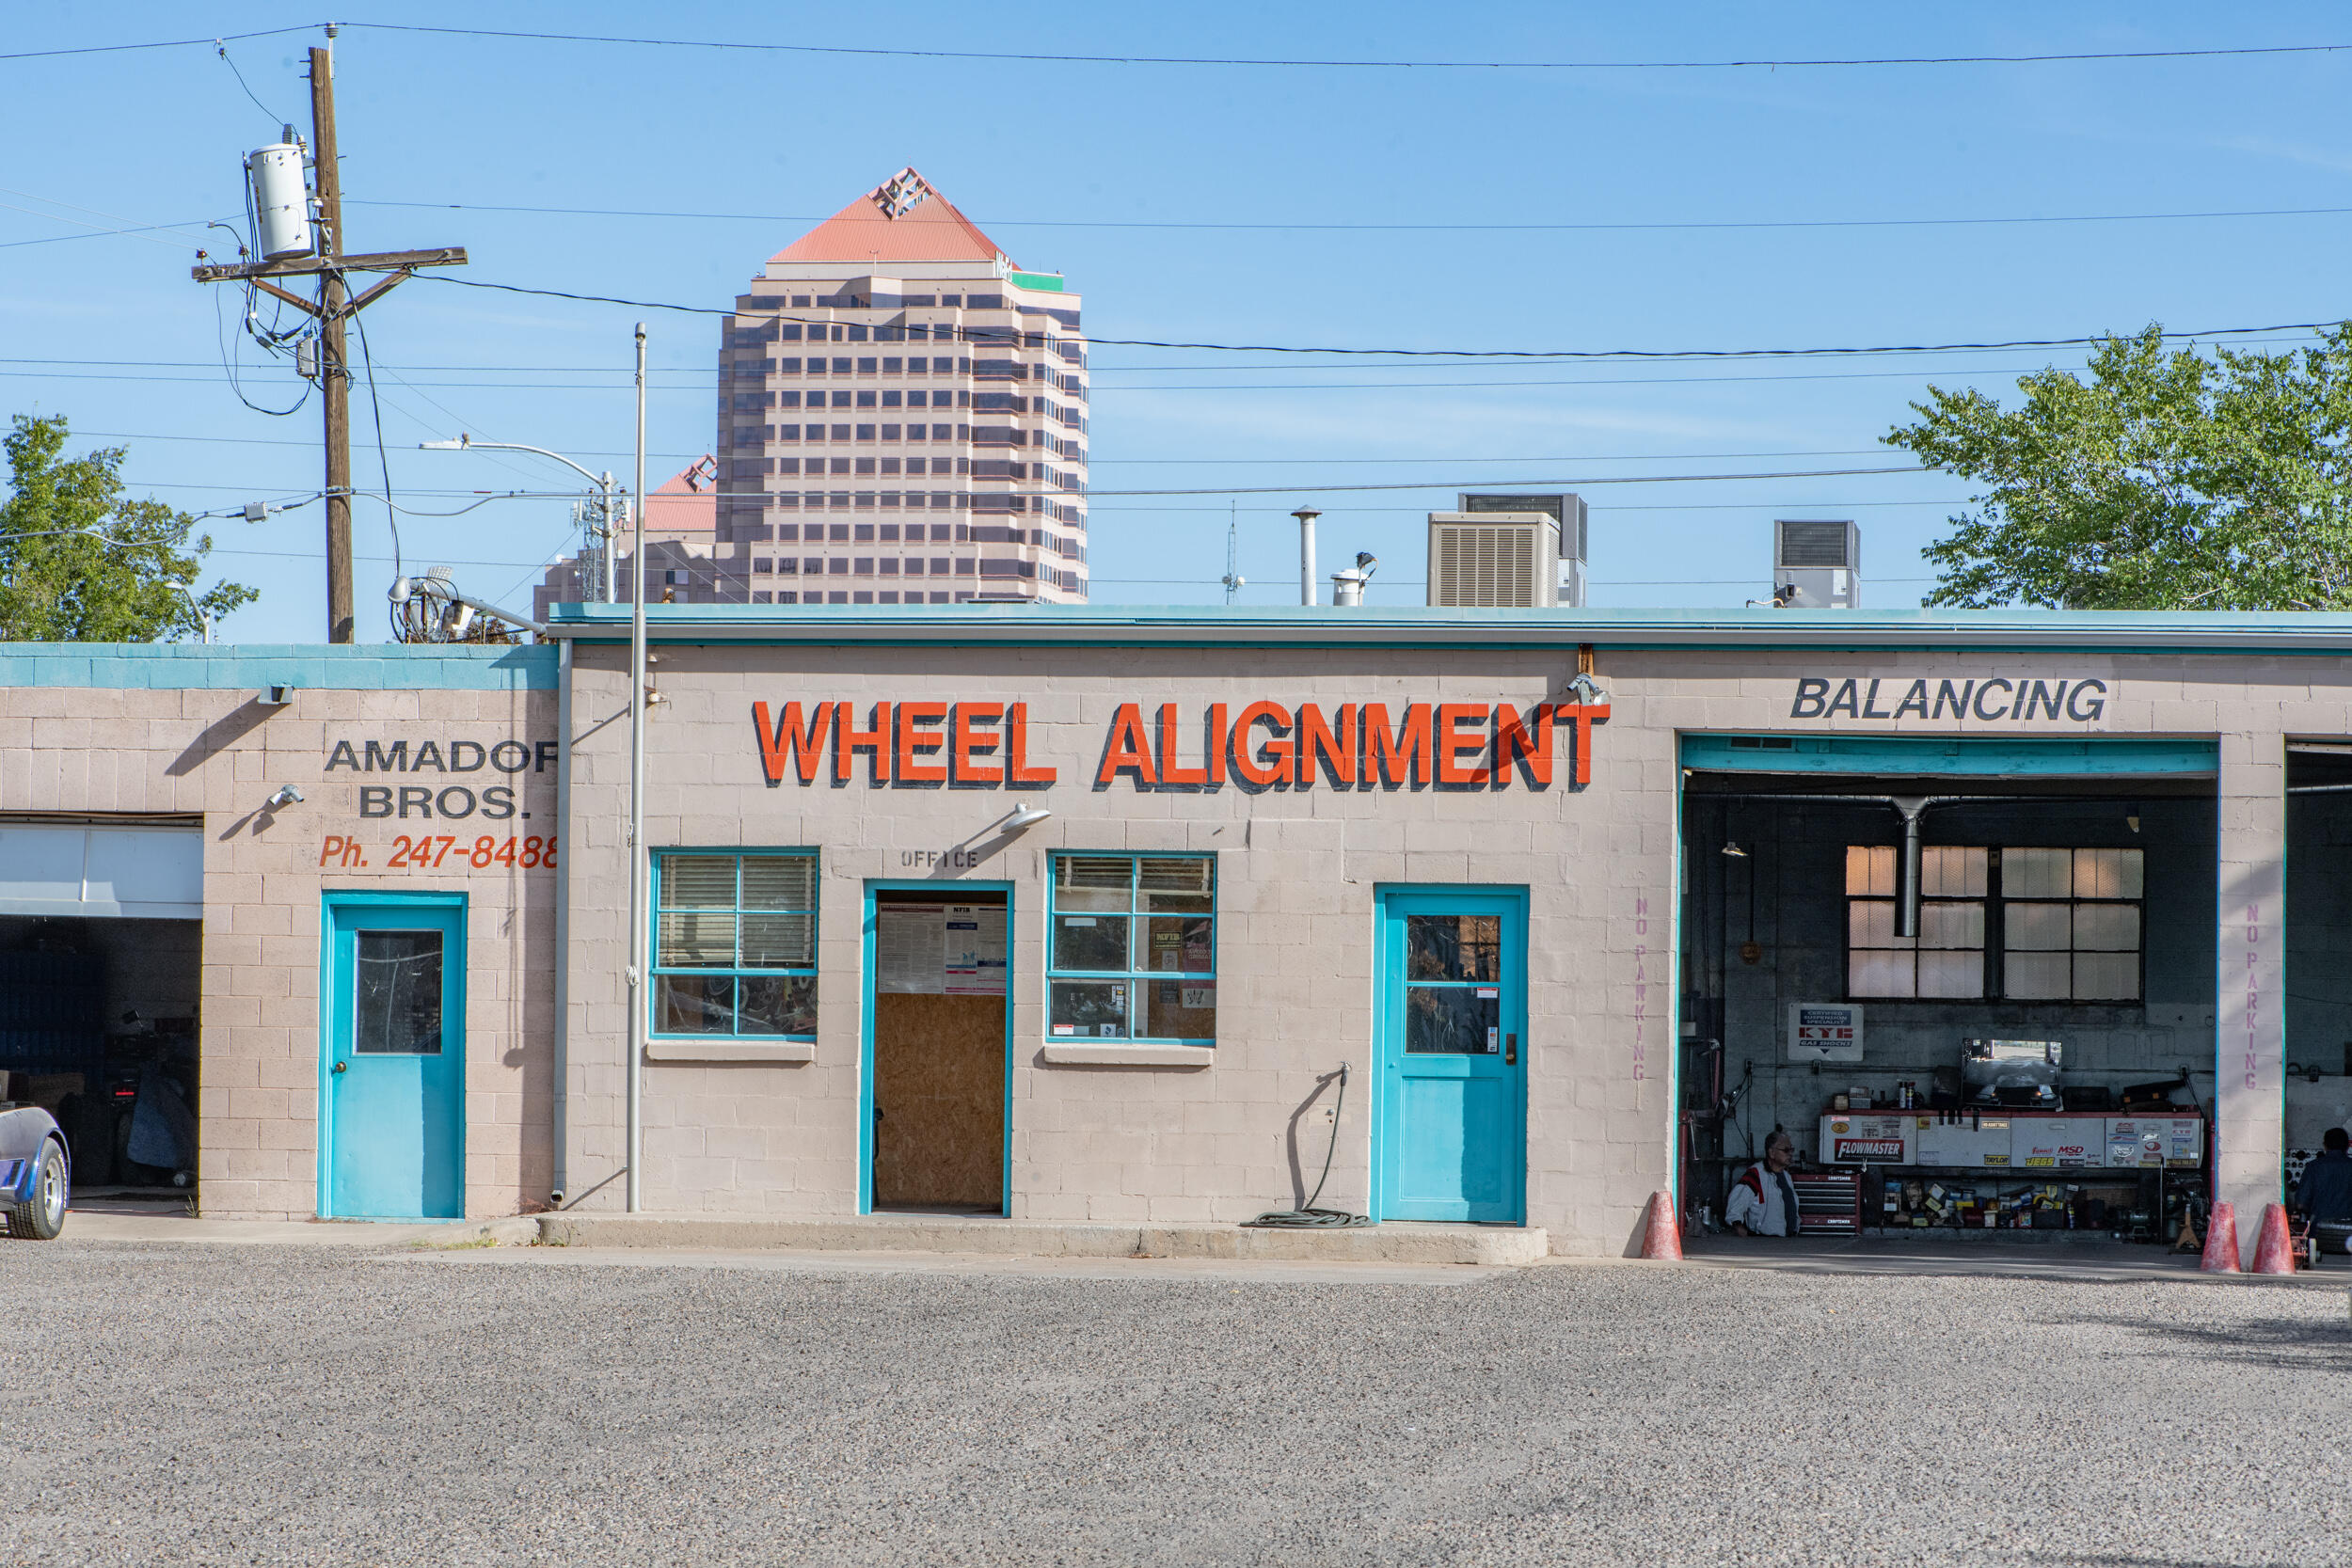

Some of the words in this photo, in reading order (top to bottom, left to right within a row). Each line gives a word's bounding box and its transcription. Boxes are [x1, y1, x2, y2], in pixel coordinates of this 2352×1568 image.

[1790, 678, 2106, 721] BALANCING
[752, 701, 1057, 791] WHEEL
[1092, 700, 1612, 795] ALIGNMENT
[359, 786, 531, 819] BROS.
[319, 835, 368, 867] Ph.
[388, 835, 557, 869] 247-8488
[901, 850, 978, 868] OFFICE
[1635, 898, 1647, 935] NO
[2247, 904, 2259, 942] NO
[1633, 944, 1647, 1081] PARKING
[2245, 952, 2258, 1089] PARKING
[1799, 1027, 1853, 1038] KYB
[1837, 1142, 1900, 1159] FLOWMASTER
[2058, 1146, 2084, 1154] MSD
